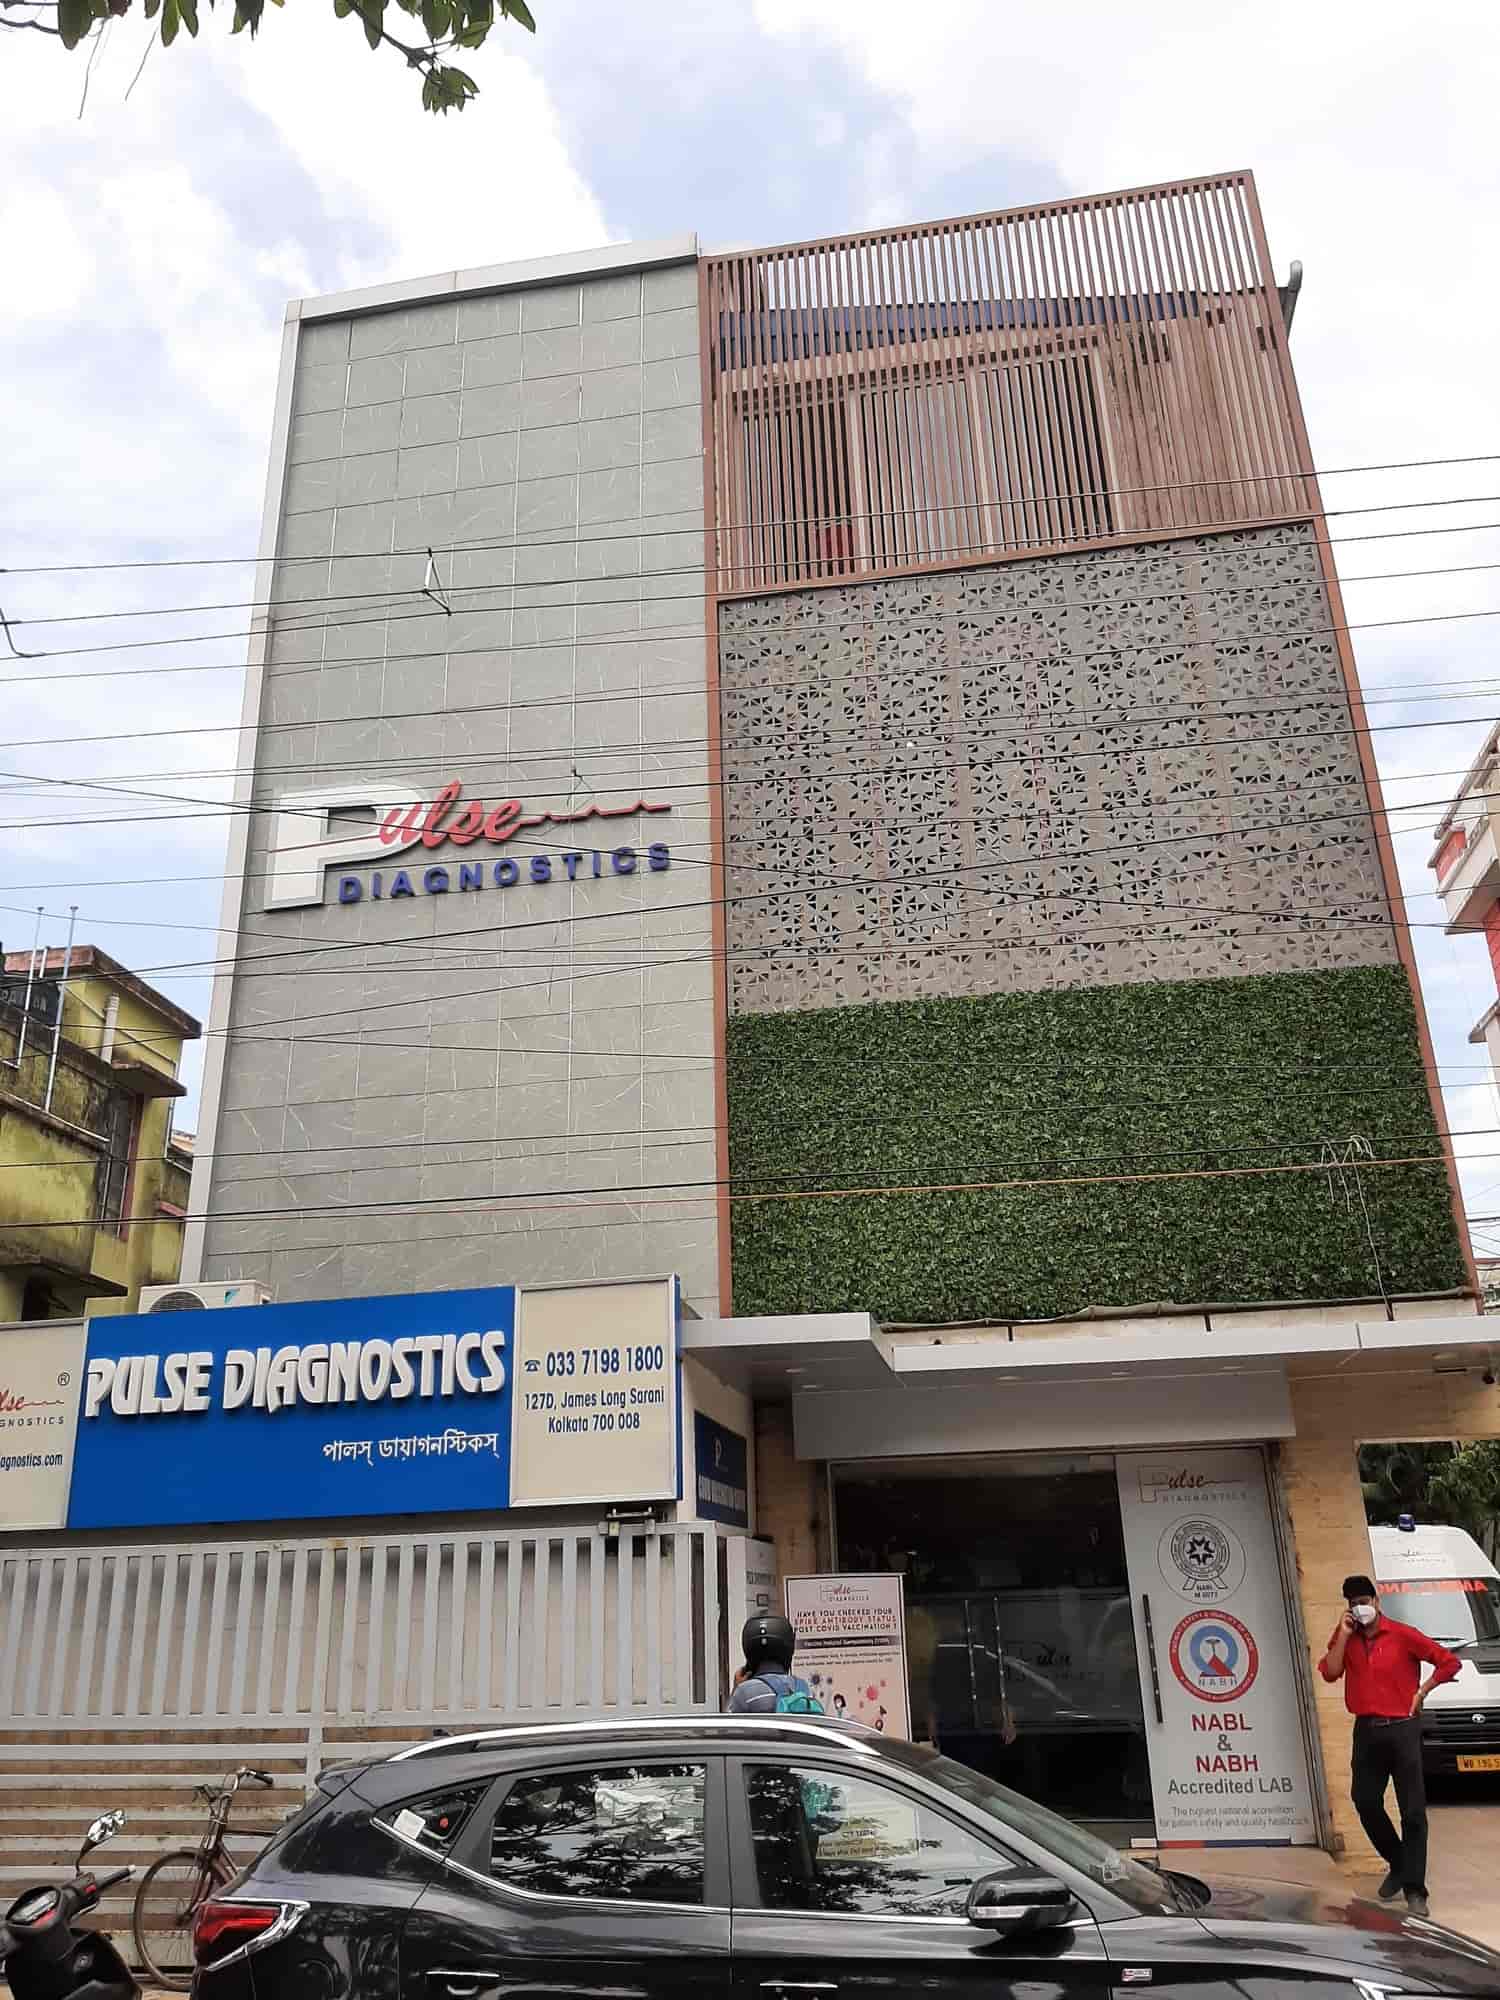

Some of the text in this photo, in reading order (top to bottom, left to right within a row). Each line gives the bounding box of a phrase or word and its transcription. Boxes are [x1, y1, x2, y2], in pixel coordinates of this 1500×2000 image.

[338, 843, 671, 904] DIAGNOSTICS
[546, 1346, 664, 1376] 033 7198 1800
[84, 1331, 506, 1418] PULSE DIAGNOSTICS
[525, 1386, 664, 1410] 127D, James Long Sarani
[548, 1412, 640, 1433] Kolkata 700 008
[1191, 1713, 1253, 1731] NABL
[1217, 1734, 1233, 1751] &
[1195, 1754, 1260, 1773] NABH
[1168, 1777, 1294, 1795] Accredited LAB
